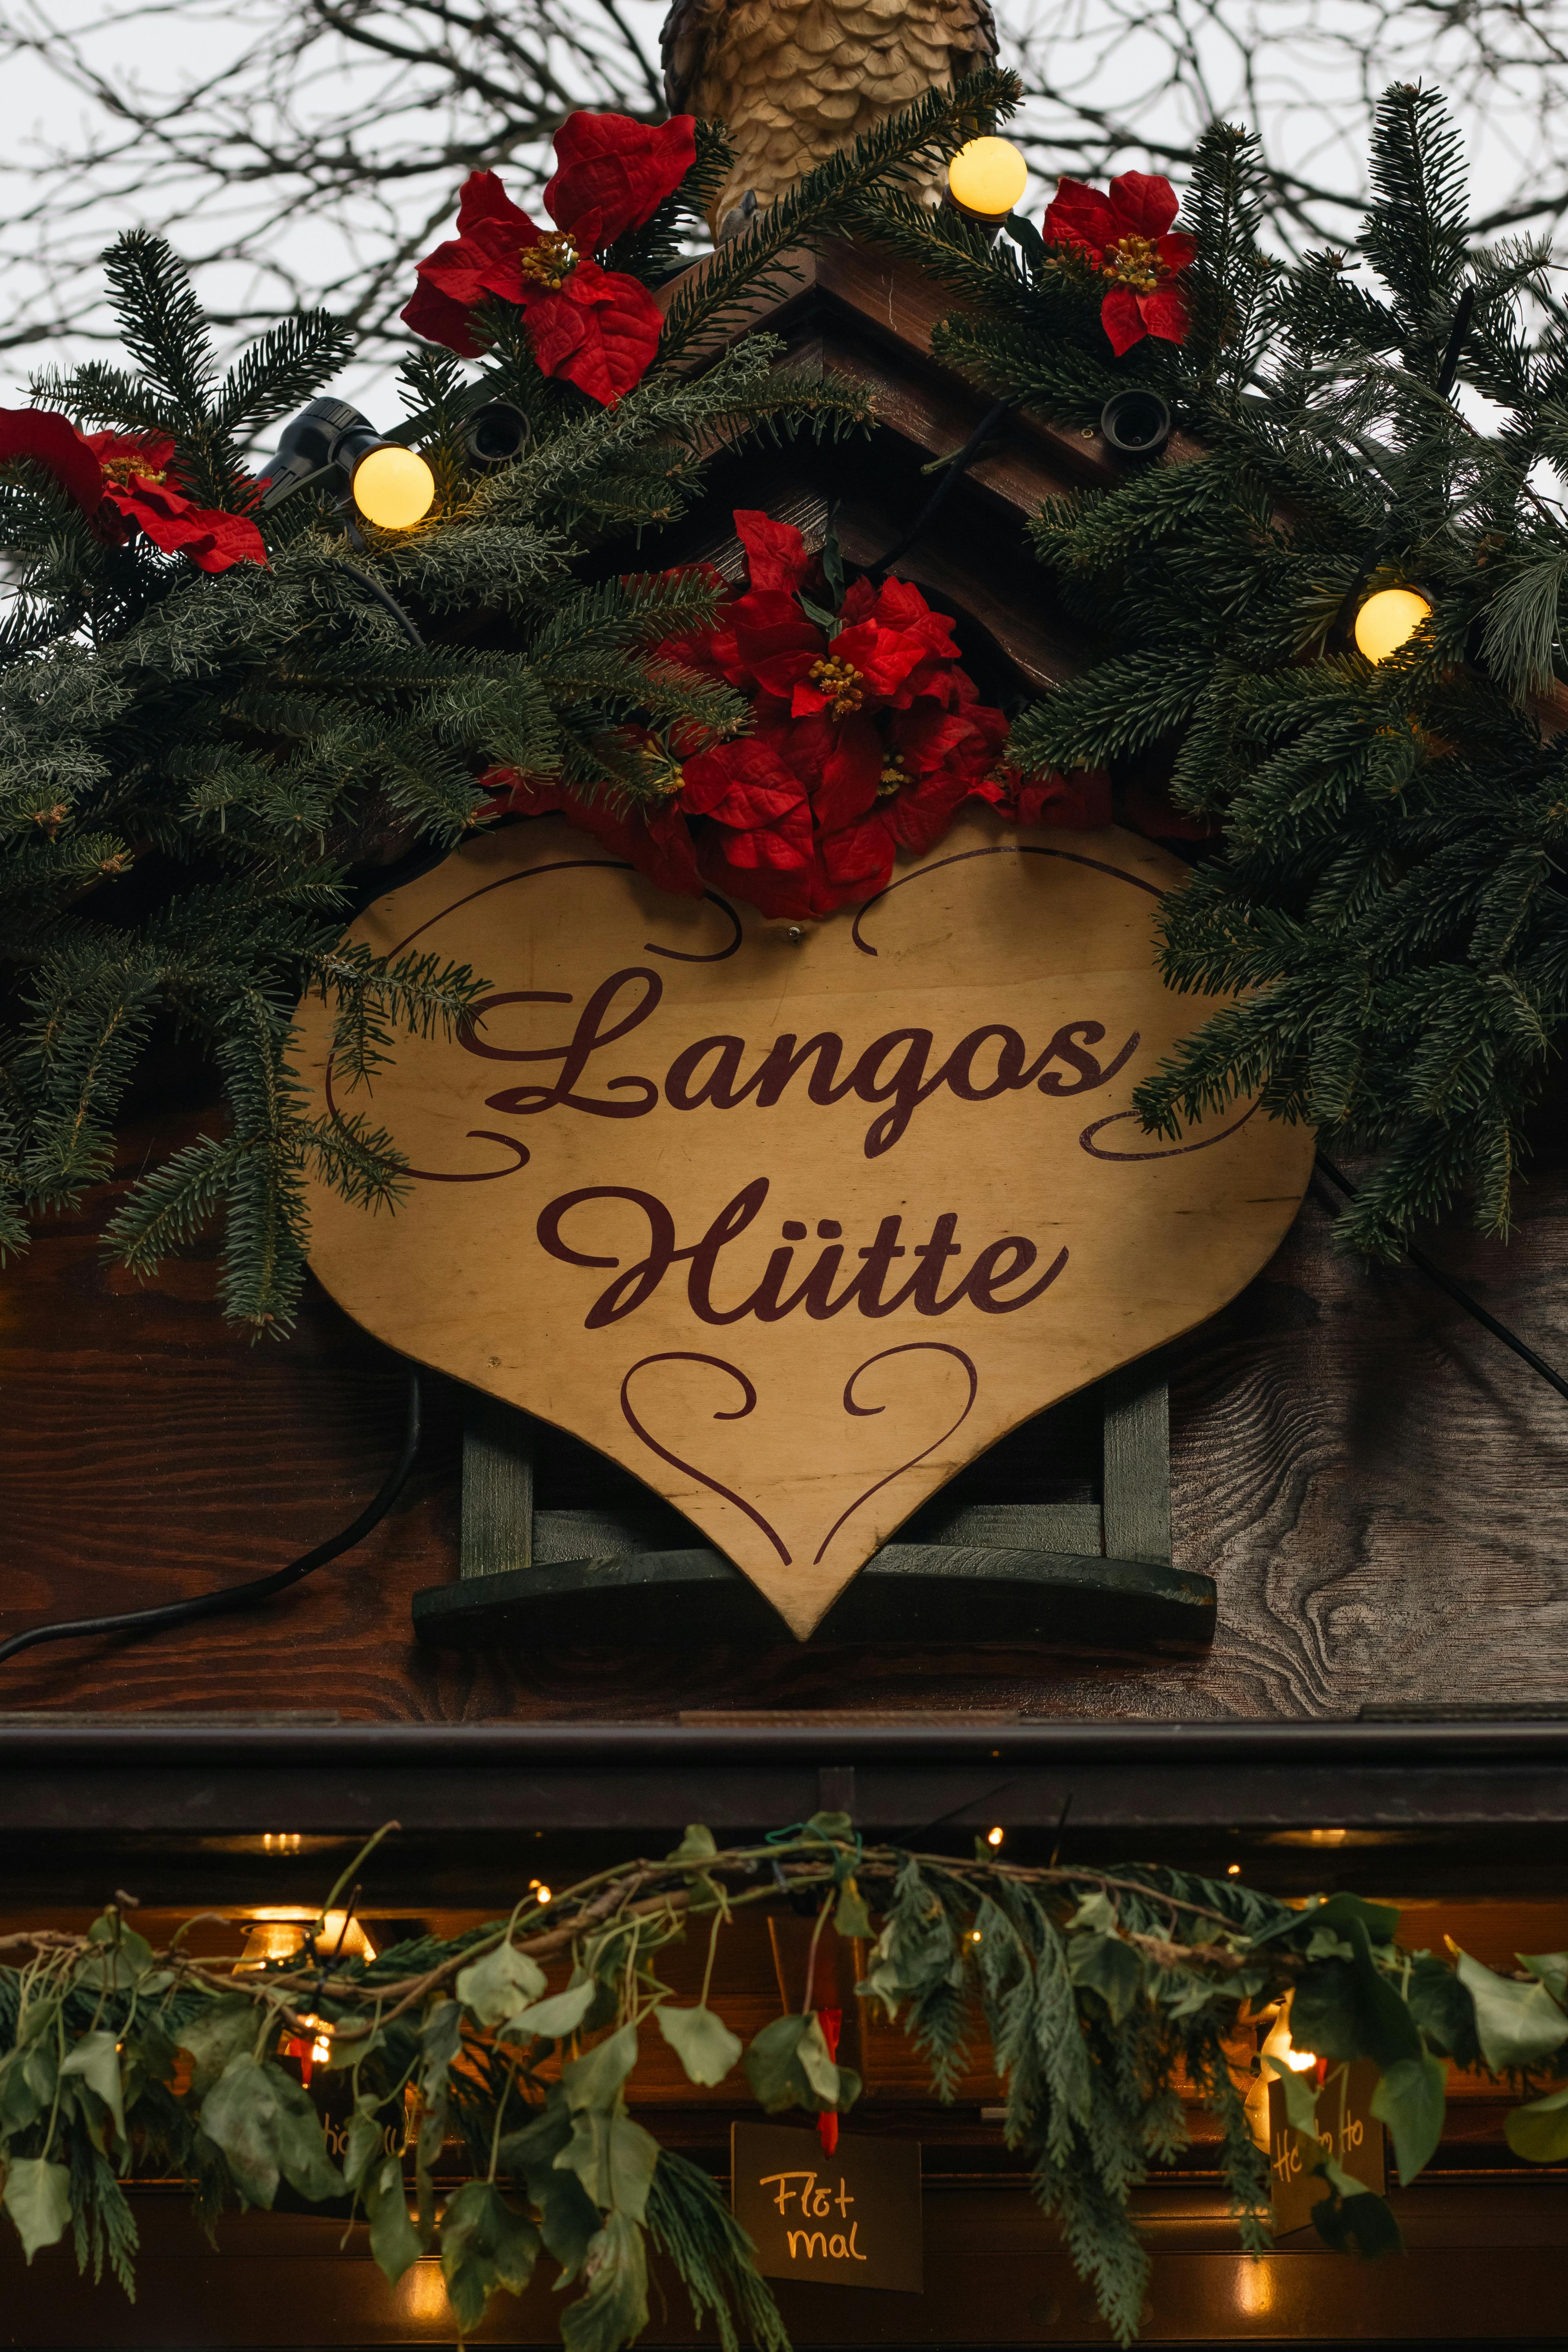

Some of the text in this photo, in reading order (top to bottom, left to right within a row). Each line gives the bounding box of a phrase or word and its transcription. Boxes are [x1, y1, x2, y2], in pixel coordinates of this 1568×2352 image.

[456, 967, 1141, 1159] Langos
[536, 1177, 1069, 1330] Hütte
[787, 2221, 867, 2260] mal
